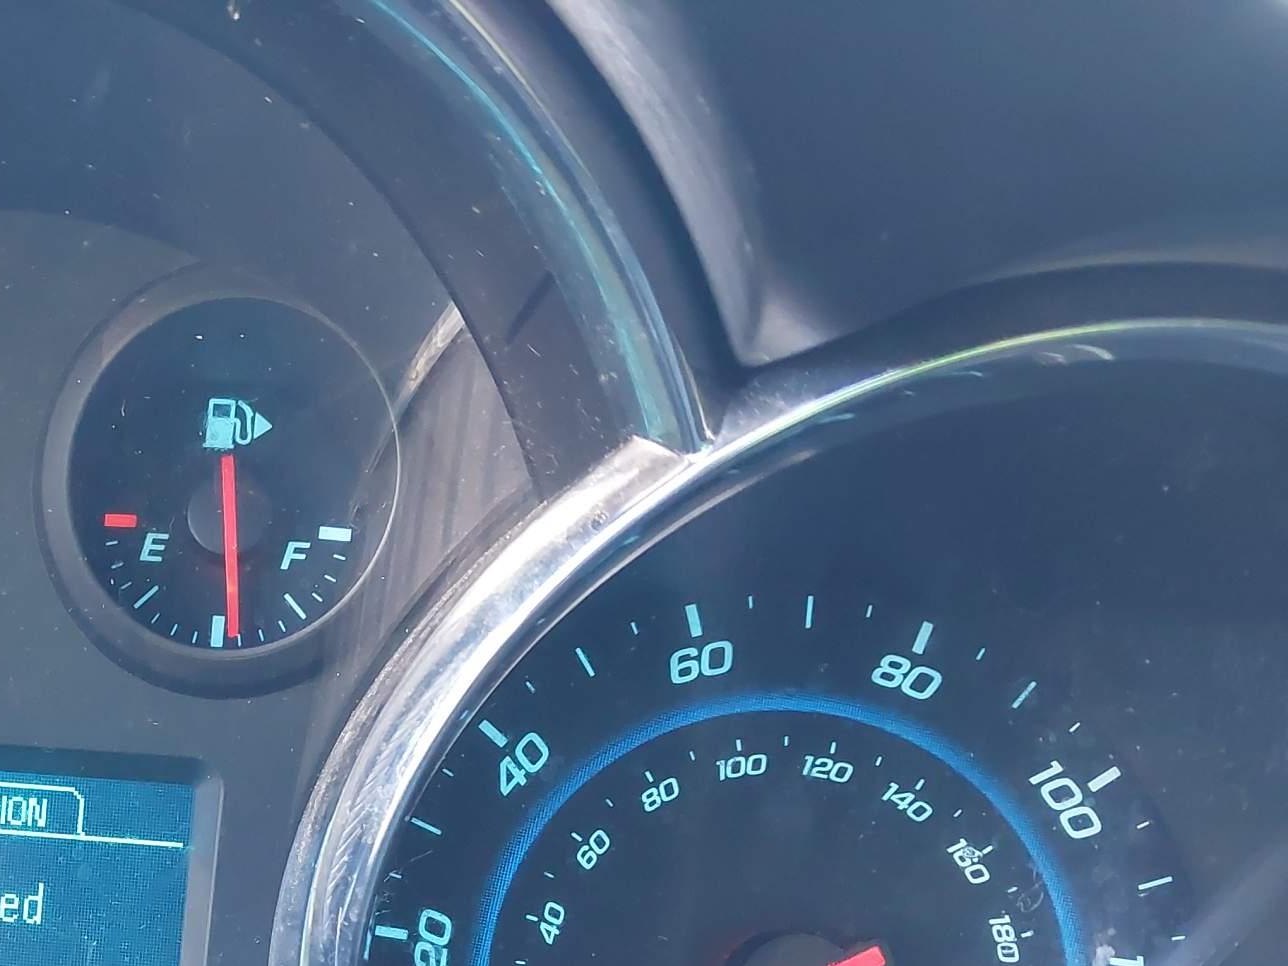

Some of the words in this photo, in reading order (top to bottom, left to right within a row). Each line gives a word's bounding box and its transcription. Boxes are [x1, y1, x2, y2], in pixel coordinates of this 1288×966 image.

[140, 533, 170, 563] E
[281, 541, 311, 570] F
[670, 640, 734, 685] 60
[871, 654, 942, 701] 80
[497, 731, 550, 797] 40
[716, 753, 767, 782] 100
[801, 755, 853, 783] 120
[641, 777, 679, 812] 80
[881, 782, 933, 822] 140
[1029, 760, 1102, 839] 100
[576, 829, 610, 870] 60
[947, 838, 990, 884] 160
[539, 901, 565, 945] 40
[988, 914, 1019, 963] 180
